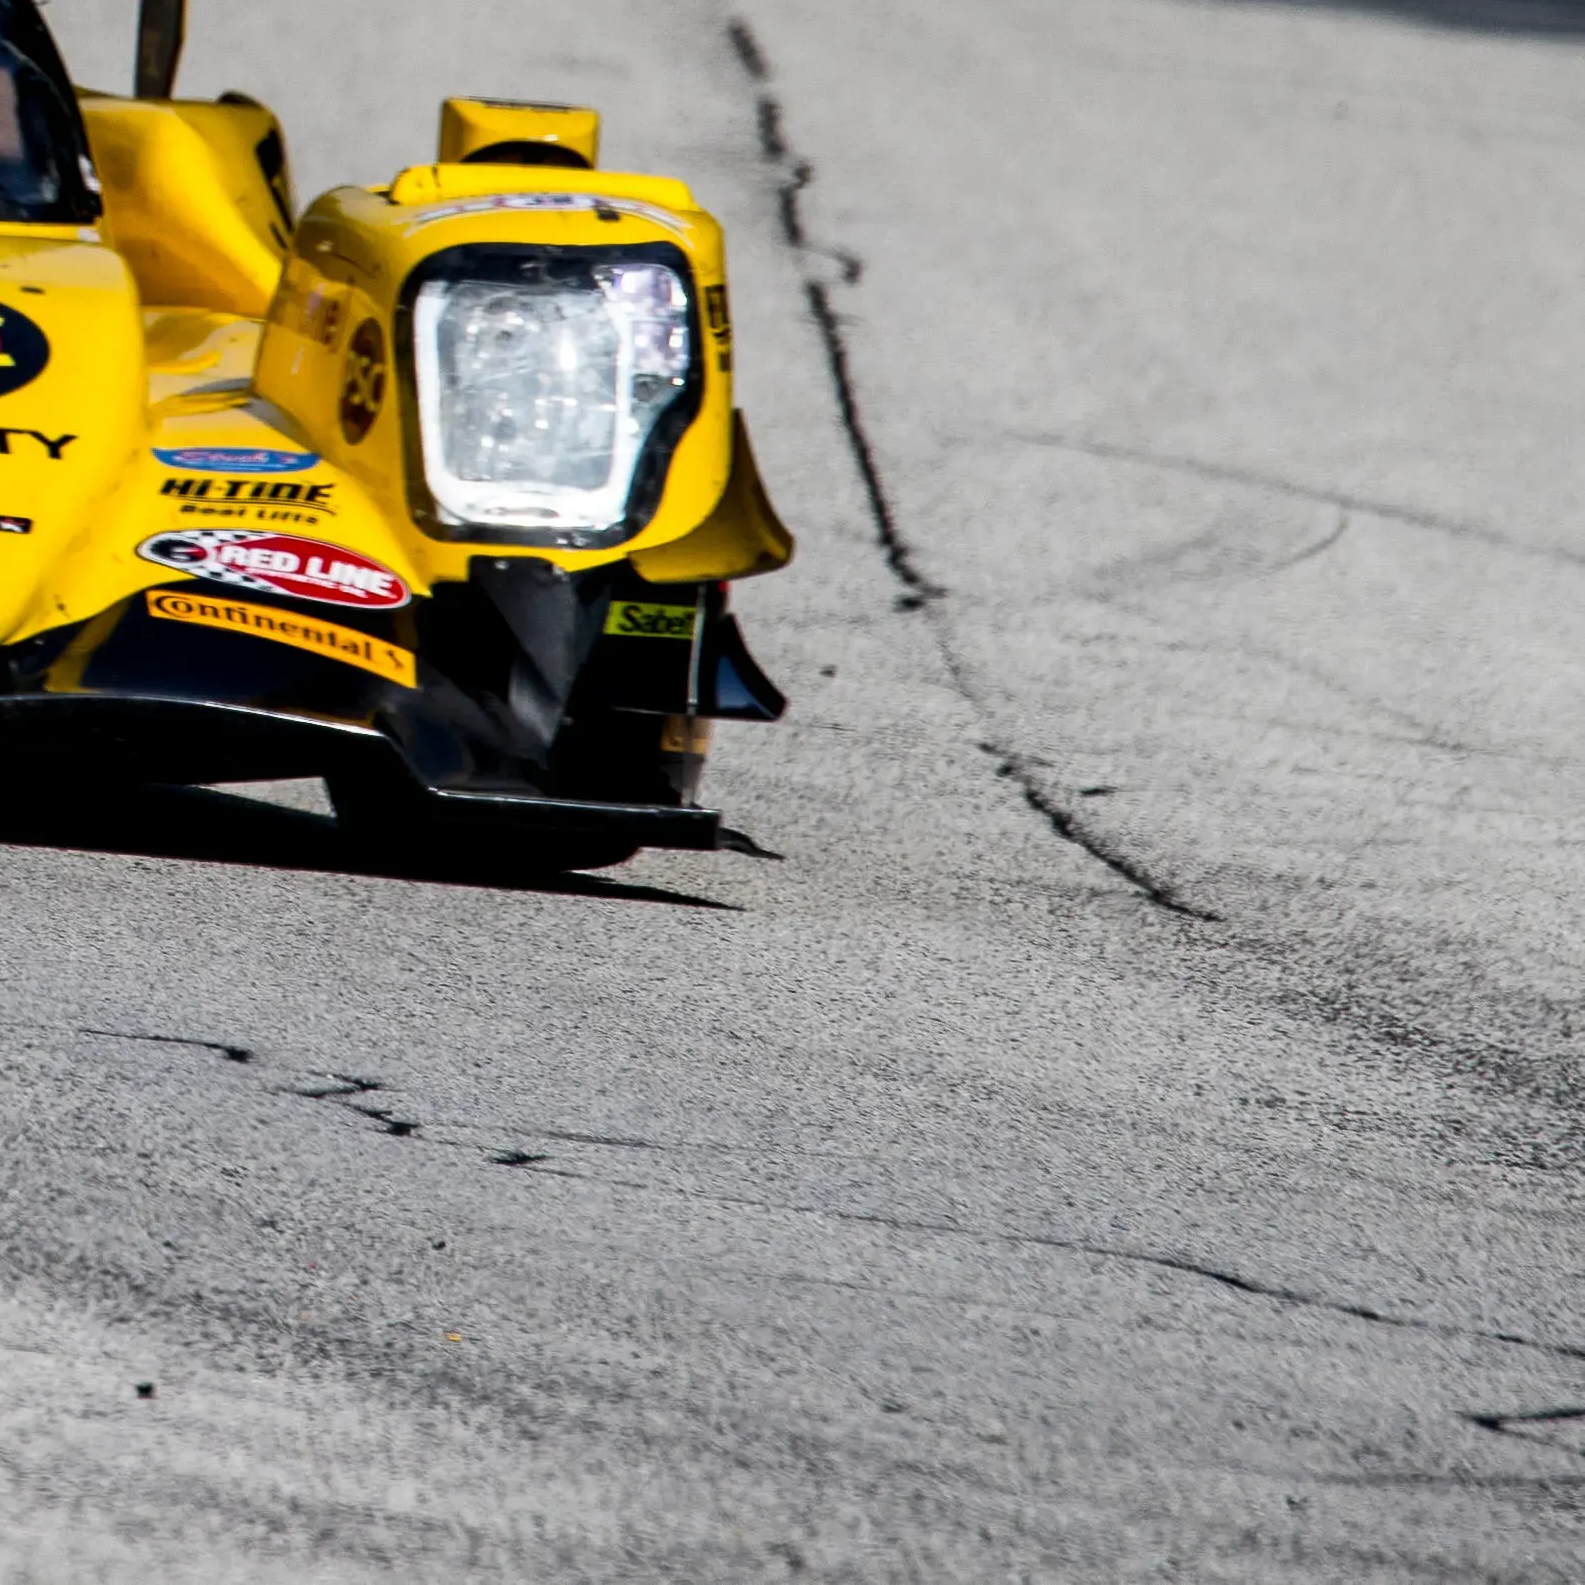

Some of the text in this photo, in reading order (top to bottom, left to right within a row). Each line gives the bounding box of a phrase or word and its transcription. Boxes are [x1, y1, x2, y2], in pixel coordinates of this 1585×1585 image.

[220, 545, 301, 573] RED
[305, 556, 399, 600] LINE
[153, 594, 375, 663] Continental
